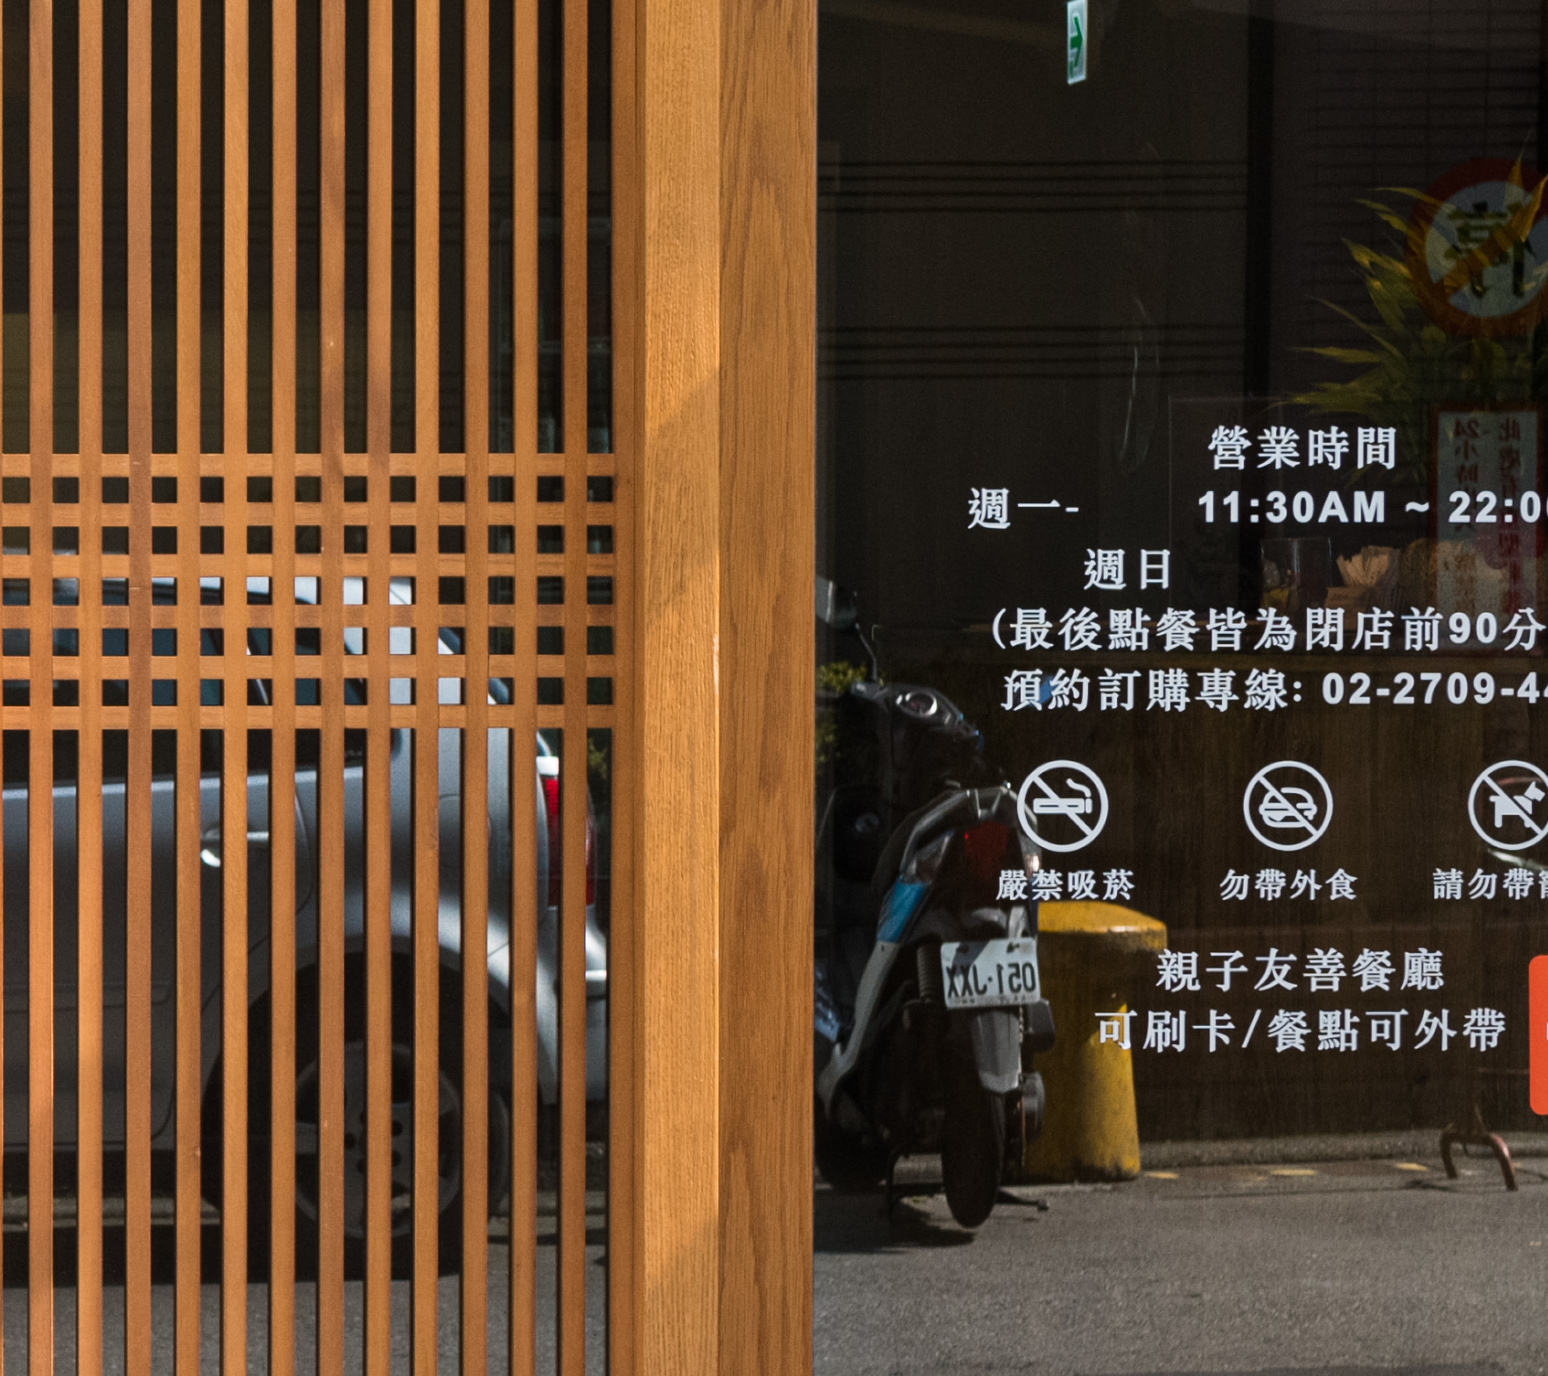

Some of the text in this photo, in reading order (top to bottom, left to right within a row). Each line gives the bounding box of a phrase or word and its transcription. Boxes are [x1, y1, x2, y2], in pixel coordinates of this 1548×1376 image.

[1208, 427, 1398, 471] 營業時間
[1197, 491, 1387, 524] 11:30AM
[1084, 550, 1173, 590] 週日
[996, 869, 1135, 902] 嚴禁吸菸
[1219, 869, 1357, 901] 勿帶外食
[1156, 949, 1445, 994] 親子友善餐廳
[1094, 1008, 1507, 1054] 可刷卡/餐點可外帶
